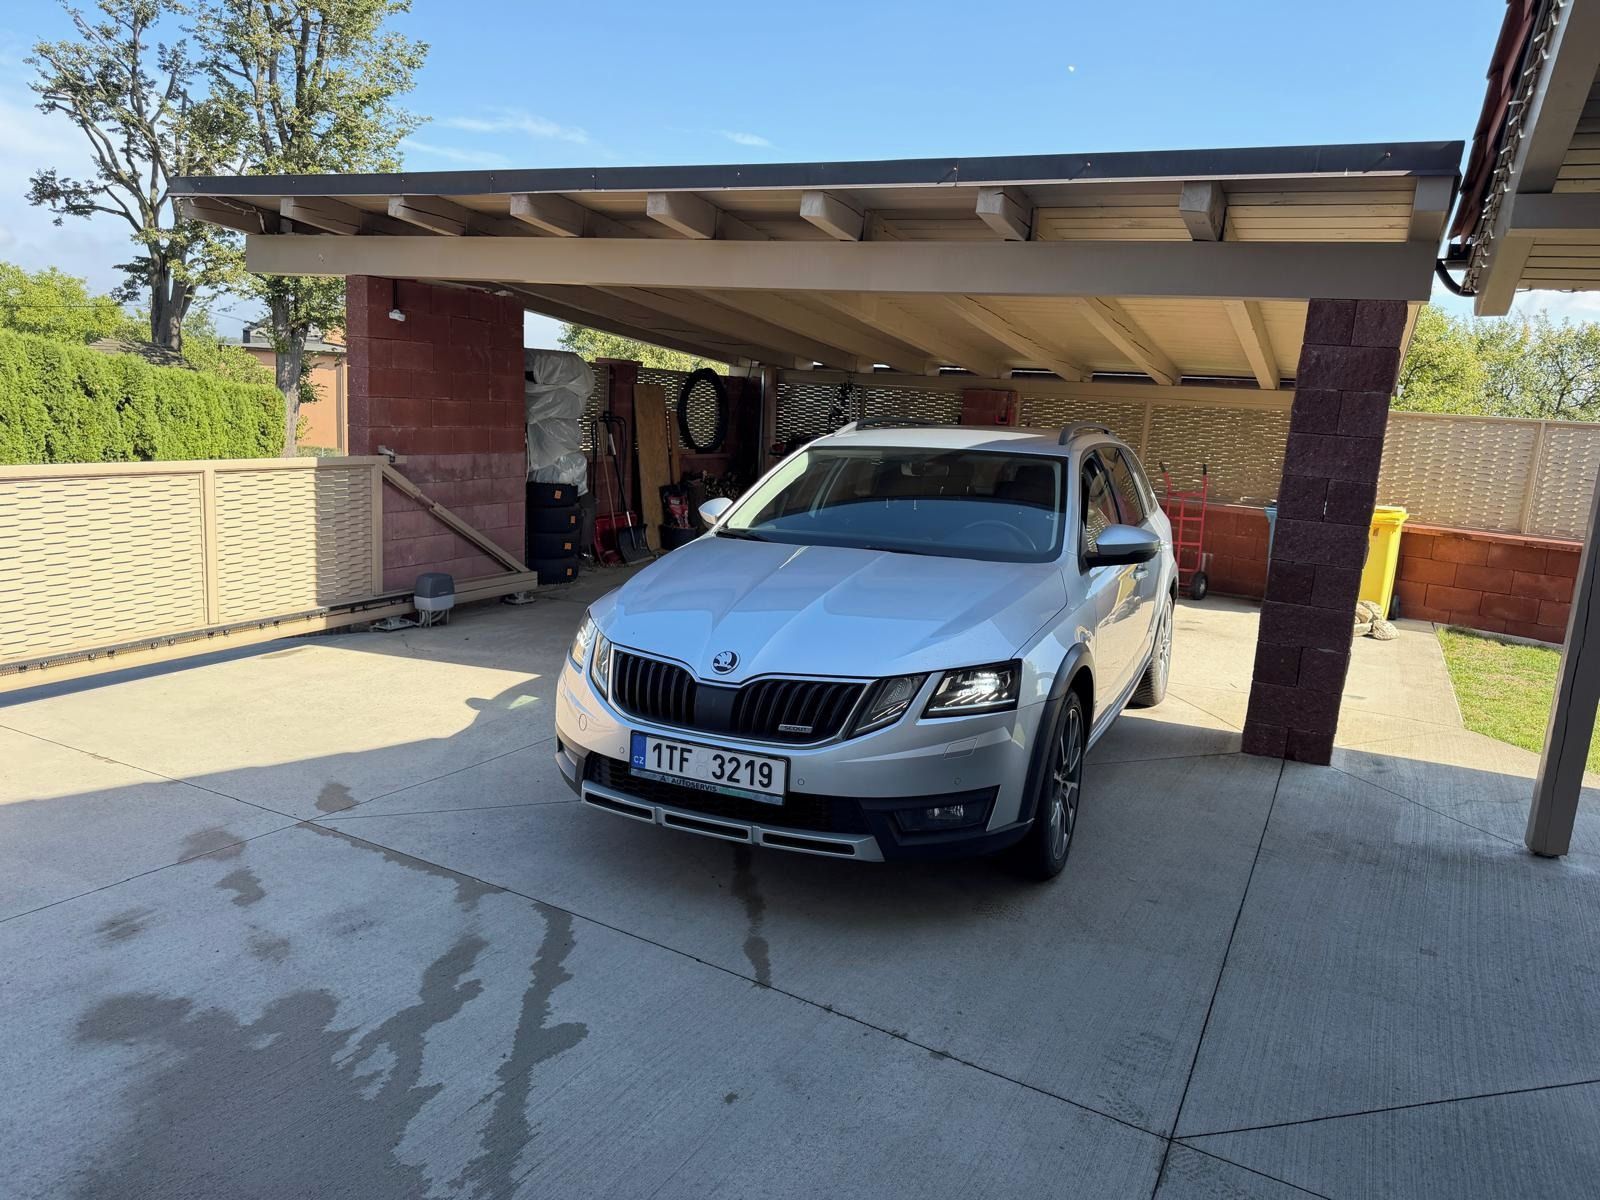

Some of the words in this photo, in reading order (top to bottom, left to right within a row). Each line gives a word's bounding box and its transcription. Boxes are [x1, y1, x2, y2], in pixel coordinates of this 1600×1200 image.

[633, 755, 645, 765] CZ
[652, 742, 693, 773] 1TF
[711, 753, 773, 788] 3219
[671, 777, 718, 793] AUTOSERVIS
